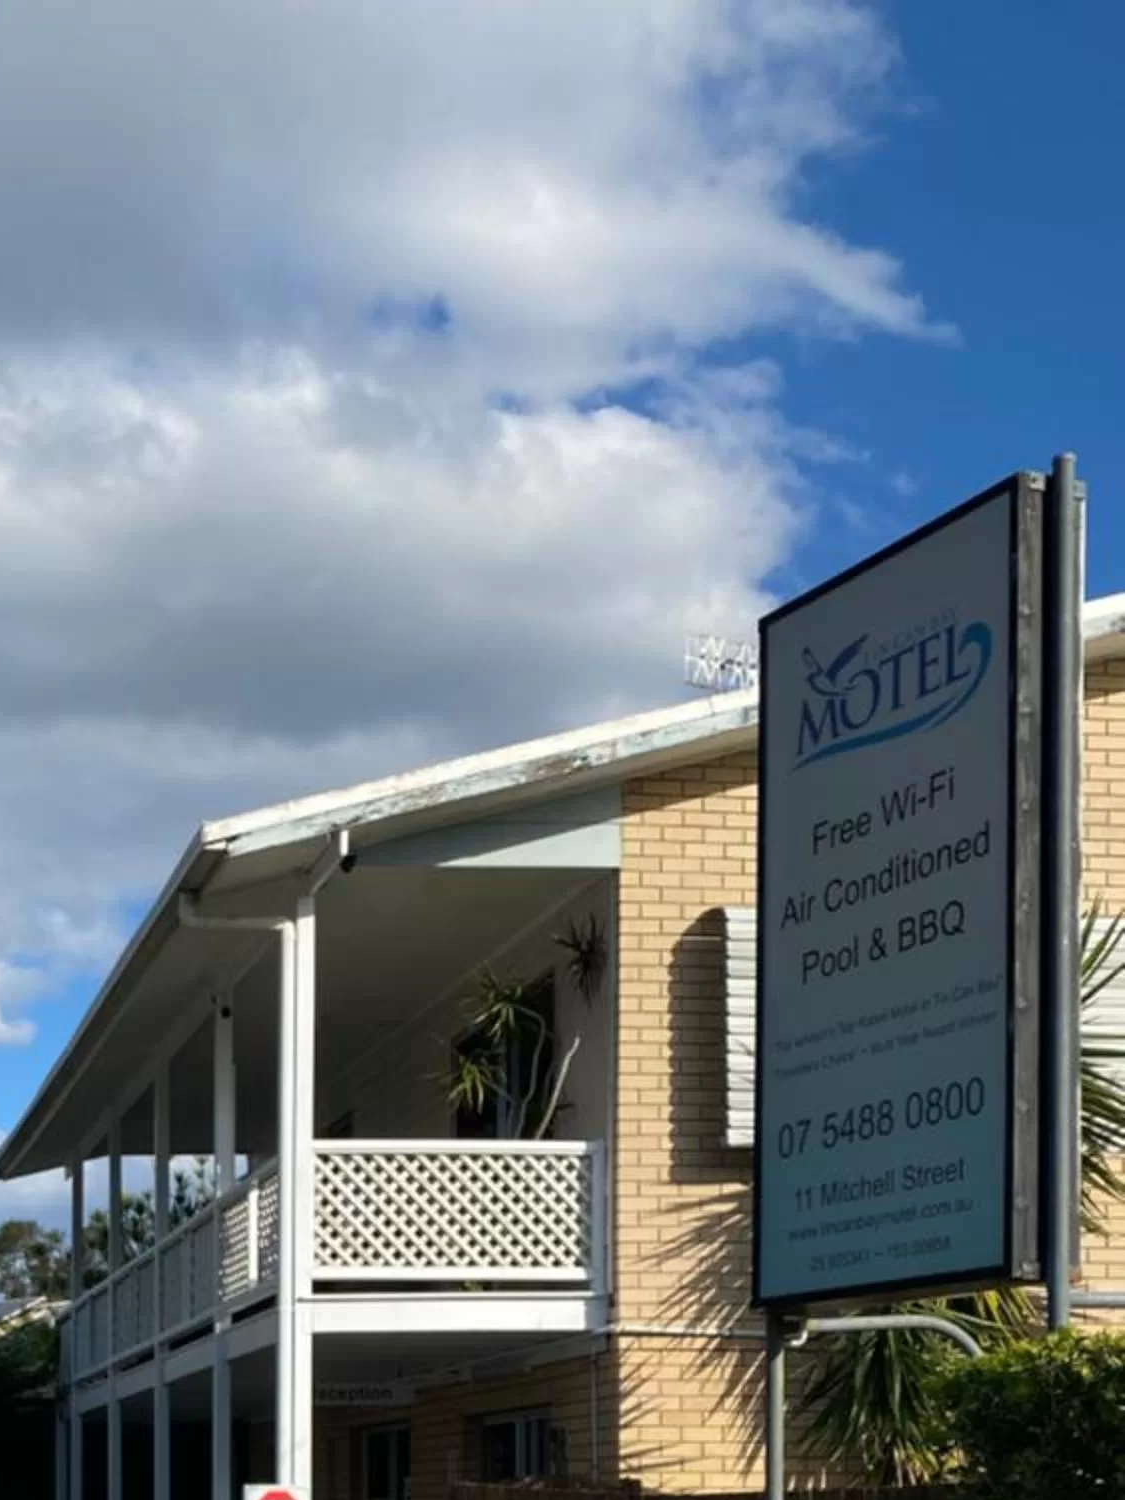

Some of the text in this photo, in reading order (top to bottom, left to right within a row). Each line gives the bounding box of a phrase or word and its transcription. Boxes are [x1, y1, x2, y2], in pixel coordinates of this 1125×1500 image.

[796, 622, 972, 757] MOTEL
[812, 767, 956, 856] Free Wi-Fi
[780, 820, 991, 929] Air Conditioned
[801, 901, 966, 985] Pool & BBQ
[778, 1076, 986, 1160] 07 5488 0800
[795, 1158, 965, 1213] 11 Mitchell Street
[315, 1384, 394, 1402] eception
